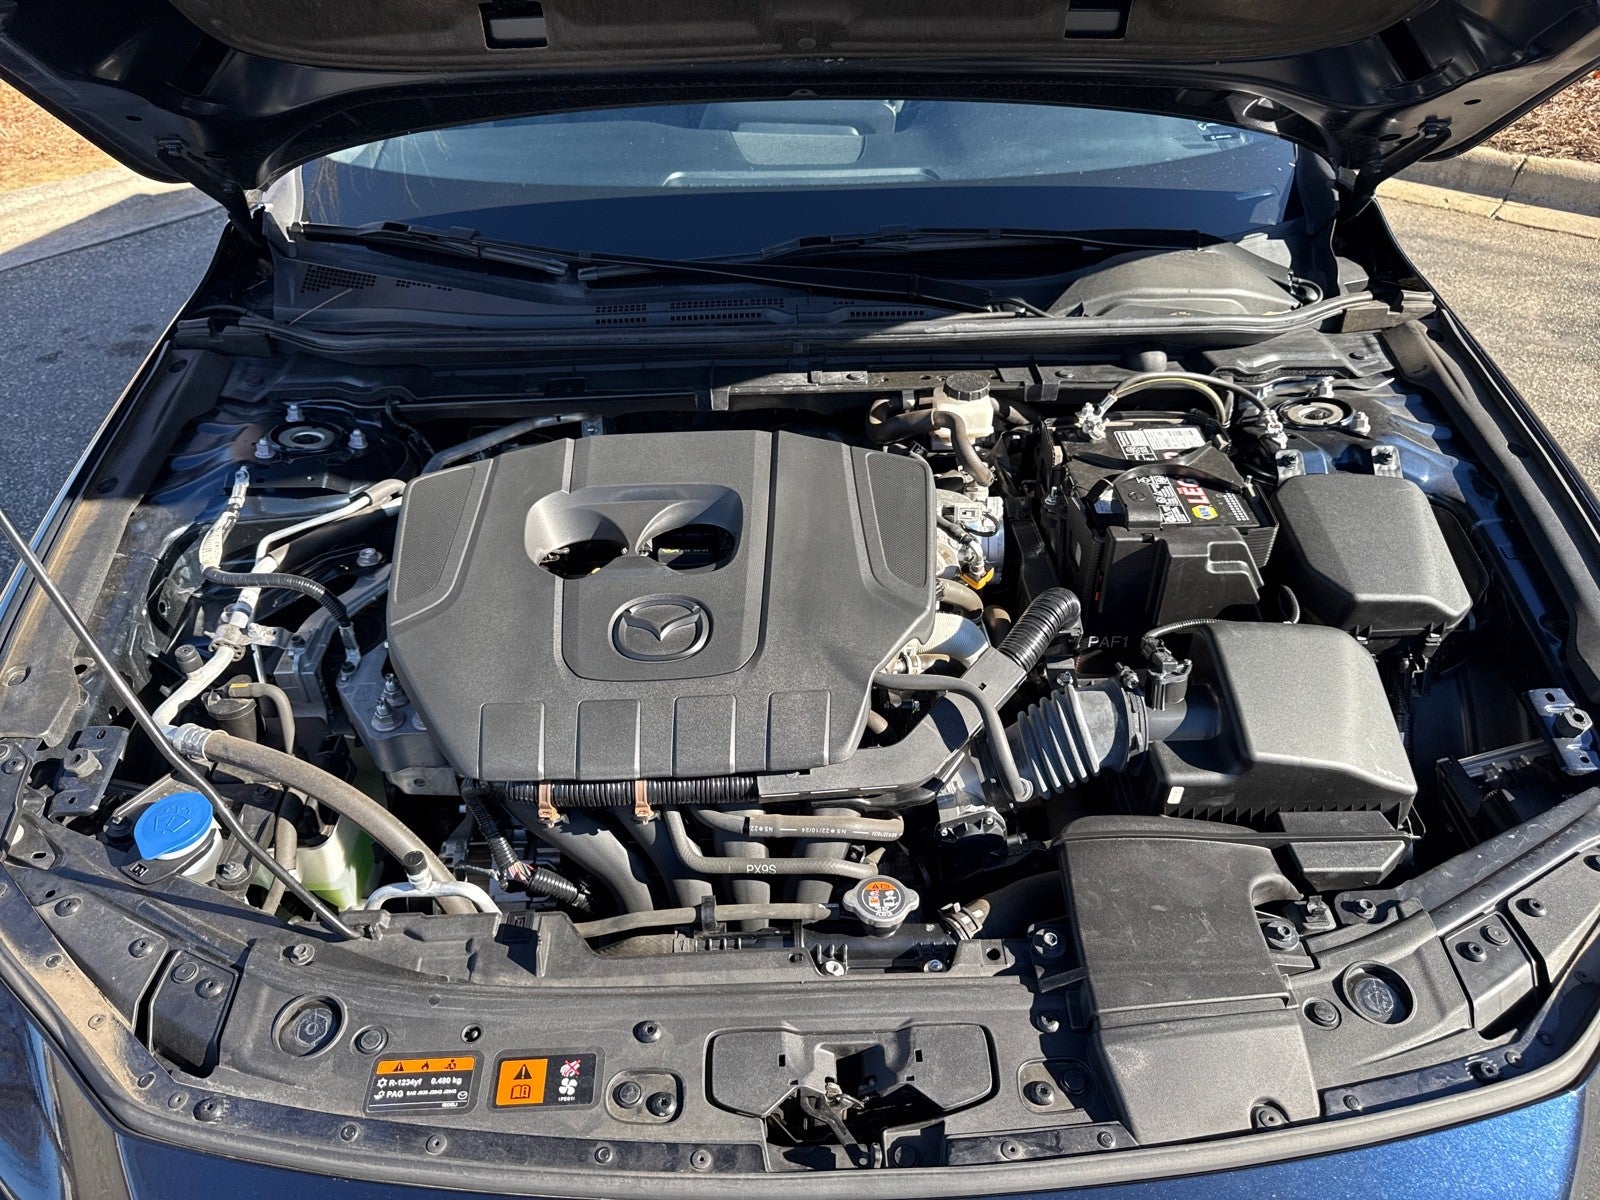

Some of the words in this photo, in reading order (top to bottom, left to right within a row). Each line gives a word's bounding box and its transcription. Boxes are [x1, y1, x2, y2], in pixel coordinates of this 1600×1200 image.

[1087, 635, 1129, 648] PAF1
[746, 864, 777, 874] PX9S
[388, 1078, 423, 1087] R-1234yf
[452, 1077, 463, 1085] kg
[386, 1090, 404, 1098] PAG
